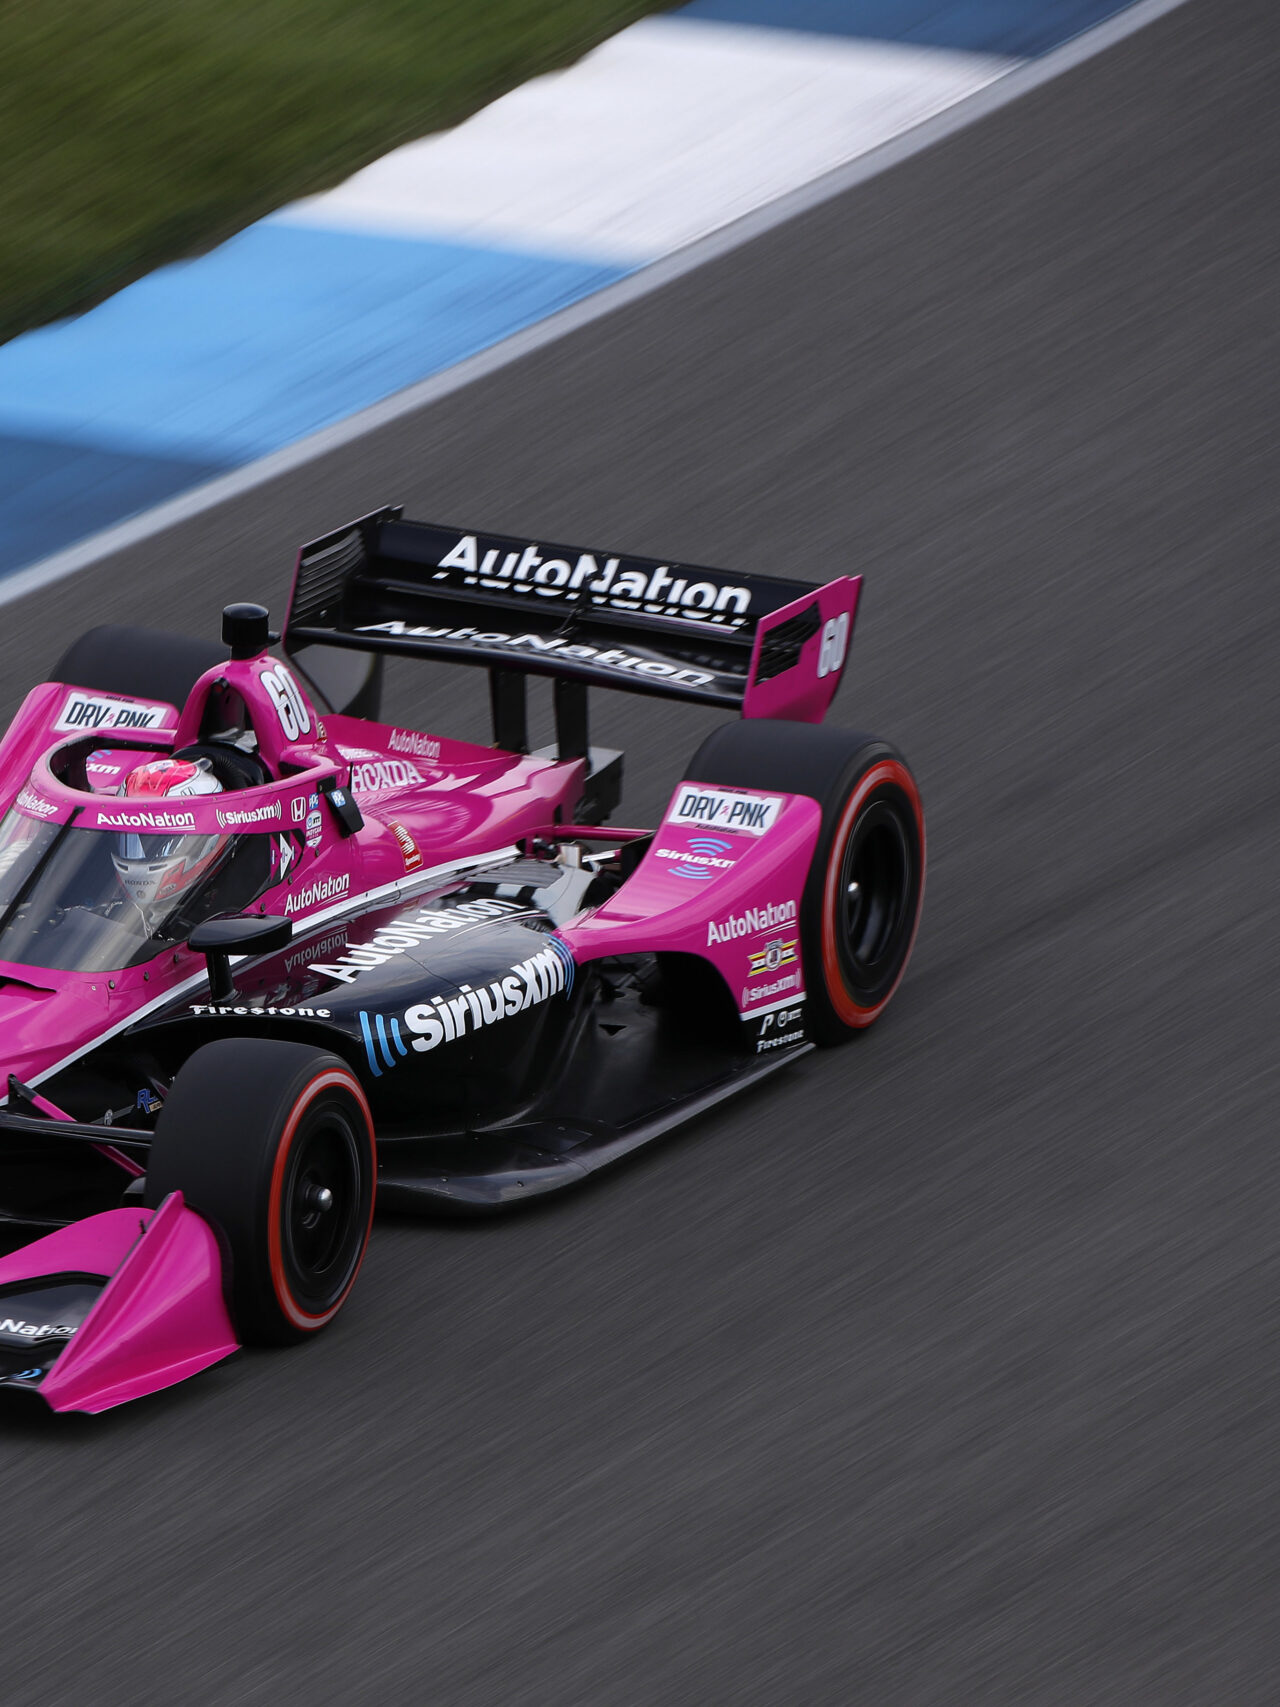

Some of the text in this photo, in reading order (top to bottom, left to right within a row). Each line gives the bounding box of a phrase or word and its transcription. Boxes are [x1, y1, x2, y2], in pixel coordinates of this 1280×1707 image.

[431, 536, 751, 626] AutoNation
[354, 620, 716, 688] AutoNation
[817, 612, 850, 678] 60
[64, 701, 155, 728] DRV PNK
[260, 664, 310, 741] 60
[387, 728, 440, 759] AutoNation
[346, 760, 426, 793] HONDA
[97, 812, 195, 827] AutoNation
[679, 794, 724, 820] DRV
[727, 801, 771, 828] PNK
[284, 873, 350, 916] AutoNation
[307, 899, 526, 984] AutoNation
[707, 900, 796, 946] AutoNation
[189, 1005, 331, 1018] Firestone
